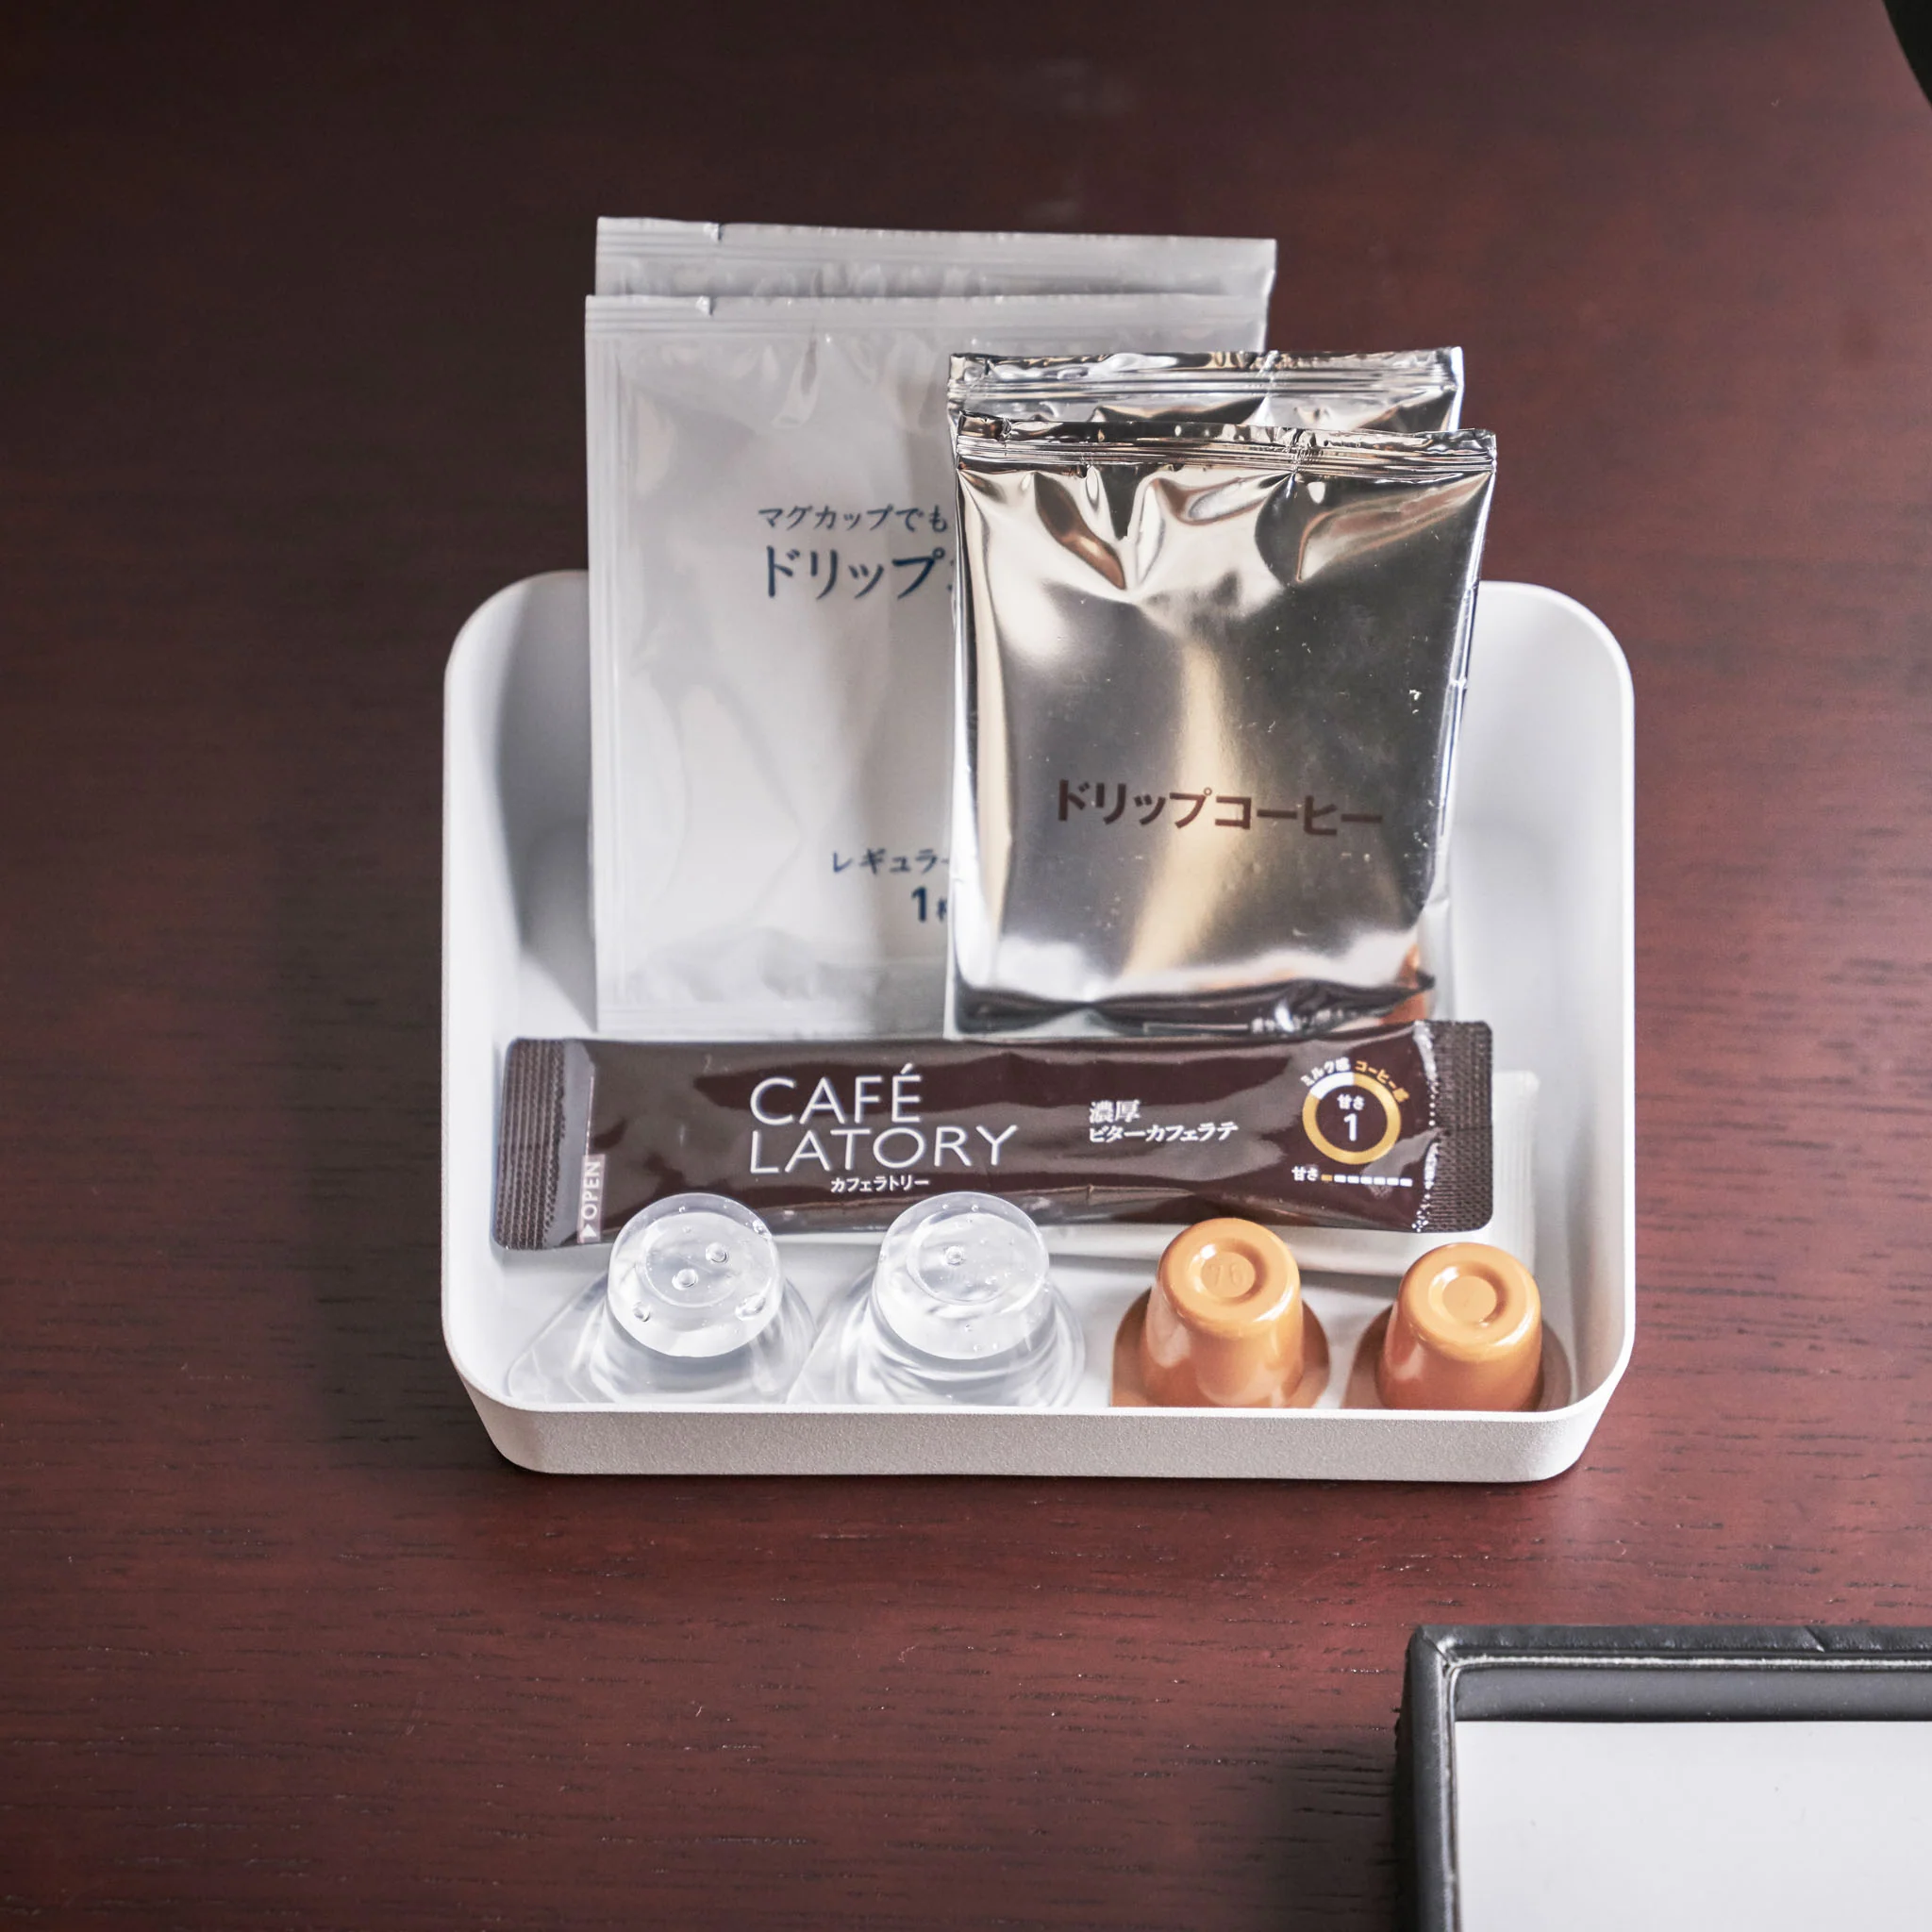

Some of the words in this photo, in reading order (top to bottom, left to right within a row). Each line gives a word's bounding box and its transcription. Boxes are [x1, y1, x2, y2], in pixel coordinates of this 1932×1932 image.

[758, 504, 948, 532] マグカップでも
[766, 545, 955, 600] ドリップ
[1058, 778, 1384, 836] ドリップコーヒー
[750, 1062, 922, 1125] CAFÉ
[1337, 1093, 1365, 1110] 甘さ
[1089, 1099, 1141, 1124] 濃厚
[1089, 1121, 1239, 1143] ビターカフェラテ
[1343, 1113, 1357, 1141] 1
[750, 1124, 1019, 1174] LATORY
[830, 1174, 929, 1193] カフェラトリー
[1291, 1165, 1319, 1181] 甘さ
[581, 1161, 601, 1221] OPEN
